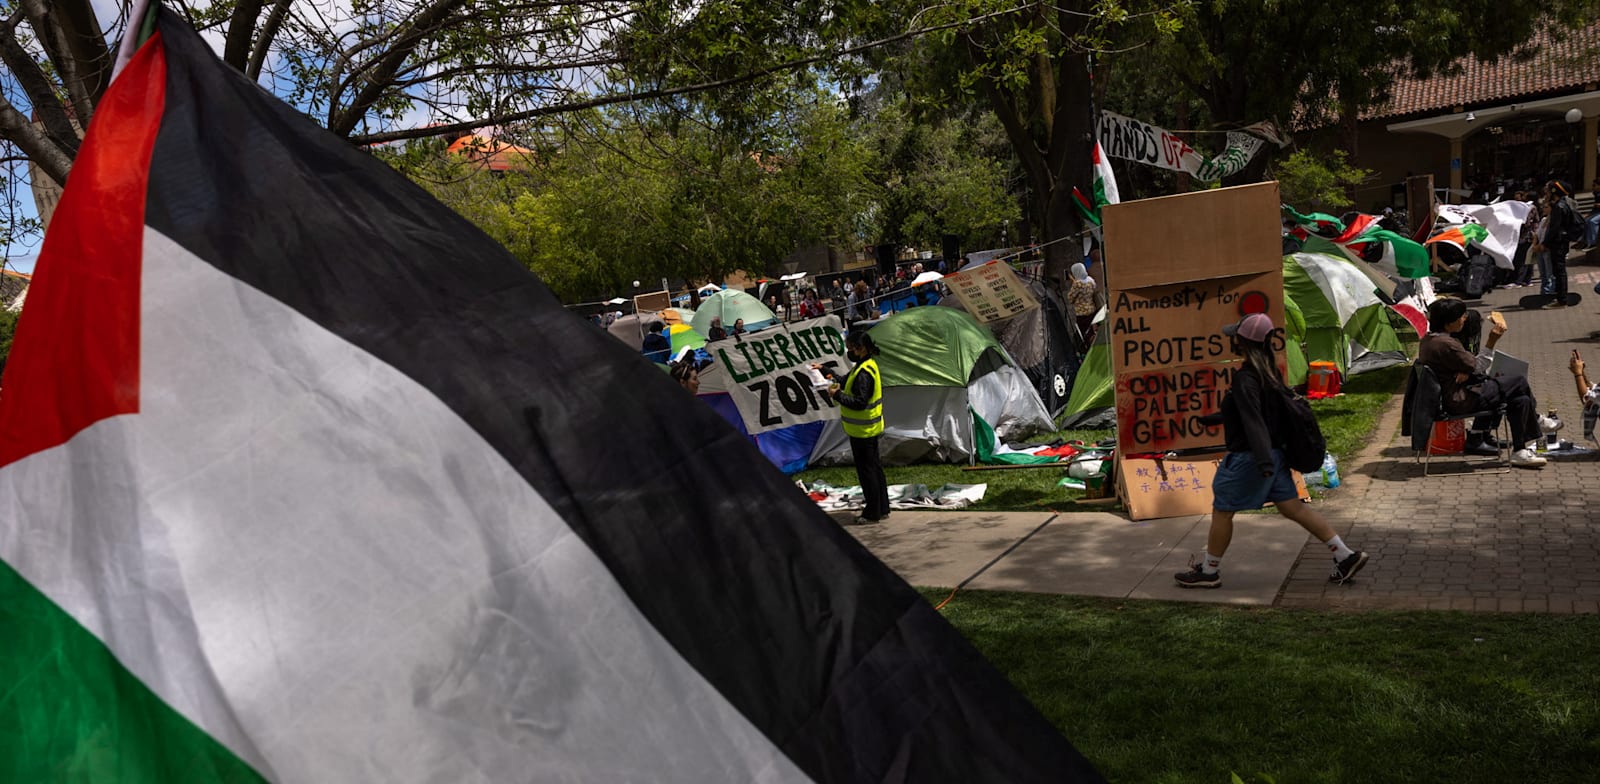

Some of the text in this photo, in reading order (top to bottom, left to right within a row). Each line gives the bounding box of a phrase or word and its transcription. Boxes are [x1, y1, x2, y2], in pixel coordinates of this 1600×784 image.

[1101, 116, 1158, 163] HANDS
[1114, 285, 1240, 313] Amnesty for
[1113, 316, 1151, 335] ALL
[718, 325, 845, 384] LIBERATED
[748, 360, 838, 427] ZON
